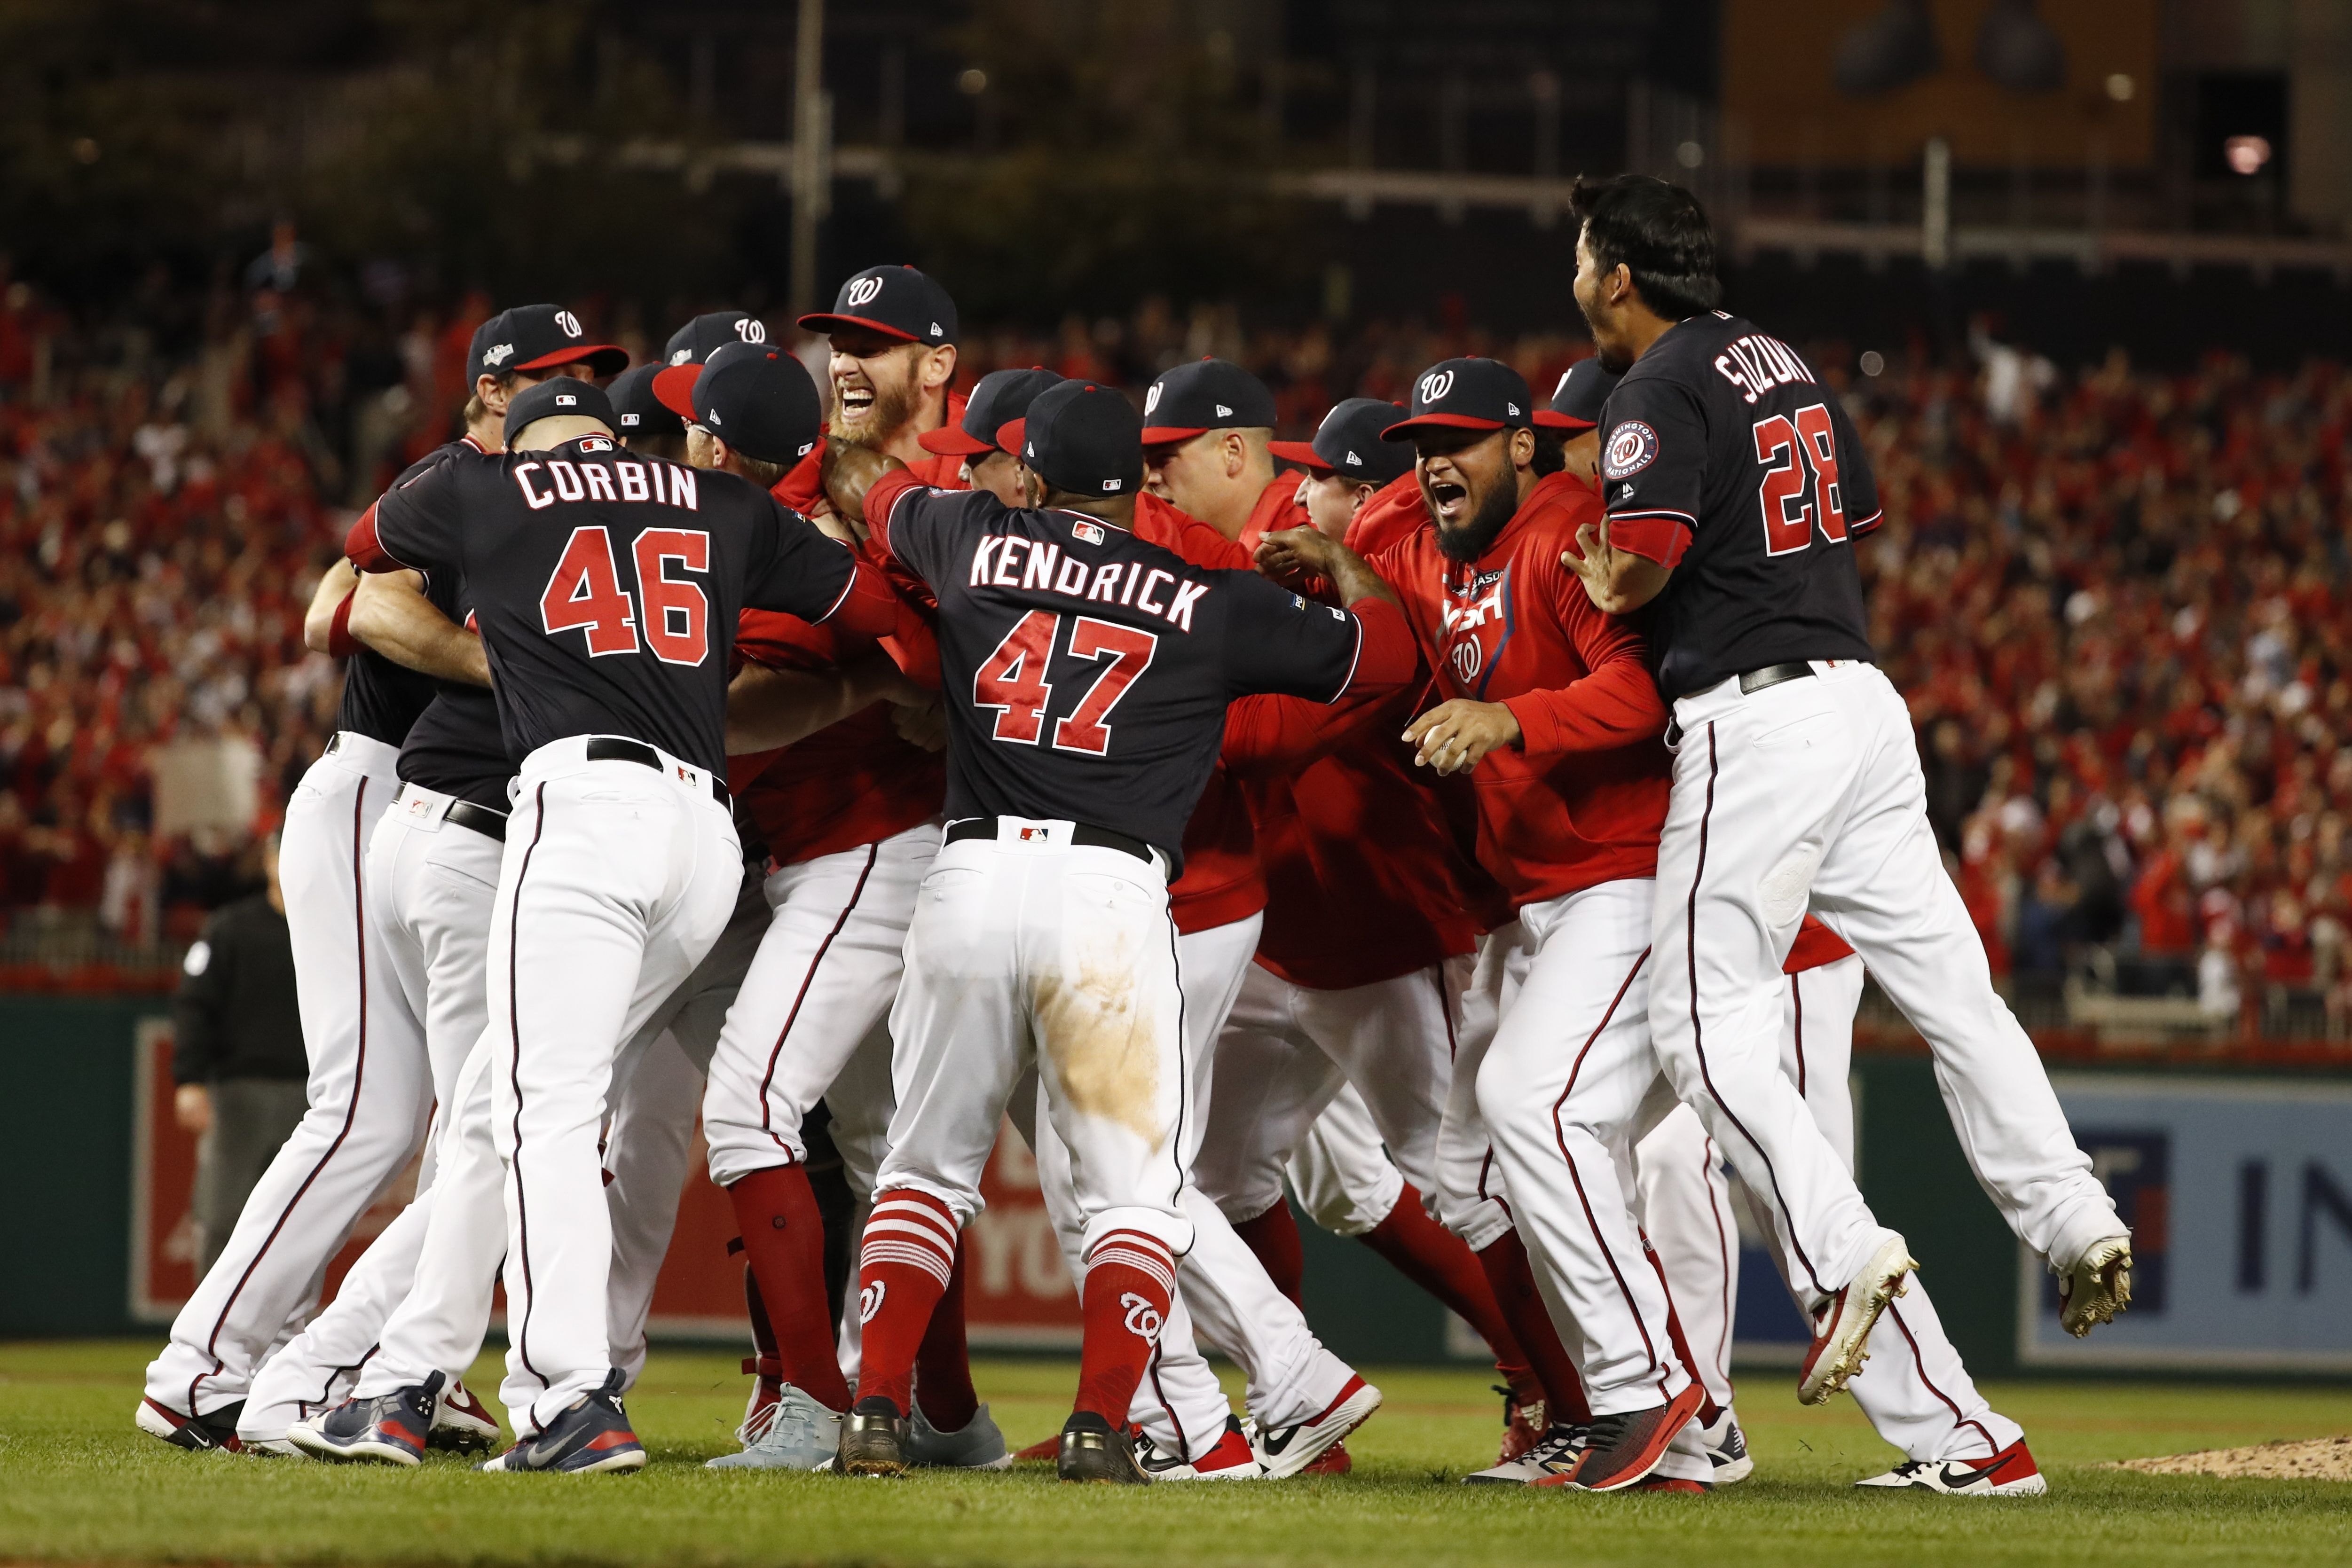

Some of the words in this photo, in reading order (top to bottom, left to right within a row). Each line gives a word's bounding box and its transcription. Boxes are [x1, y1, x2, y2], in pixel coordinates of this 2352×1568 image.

[848, 276, 883, 306] W
[555, 310, 582, 338] W
[734, 318, 766, 344] W
[1421, 370, 1454, 404] W
[1714, 333, 1817, 405] SUZUKI
[1605, 423, 1654, 455] WASHINGTON
[512, 460, 699, 511] CORBIN
[1607, 453, 1652, 477] NATIONALS
[1753, 402, 1848, 557] 28
[539, 525, 710, 667] 46
[969, 534, 1212, 635] KENDRICK
[1452, 633, 1482, 684] W
[973, 609, 1159, 757] 47
[420, 1396, 432, 1407] PC
